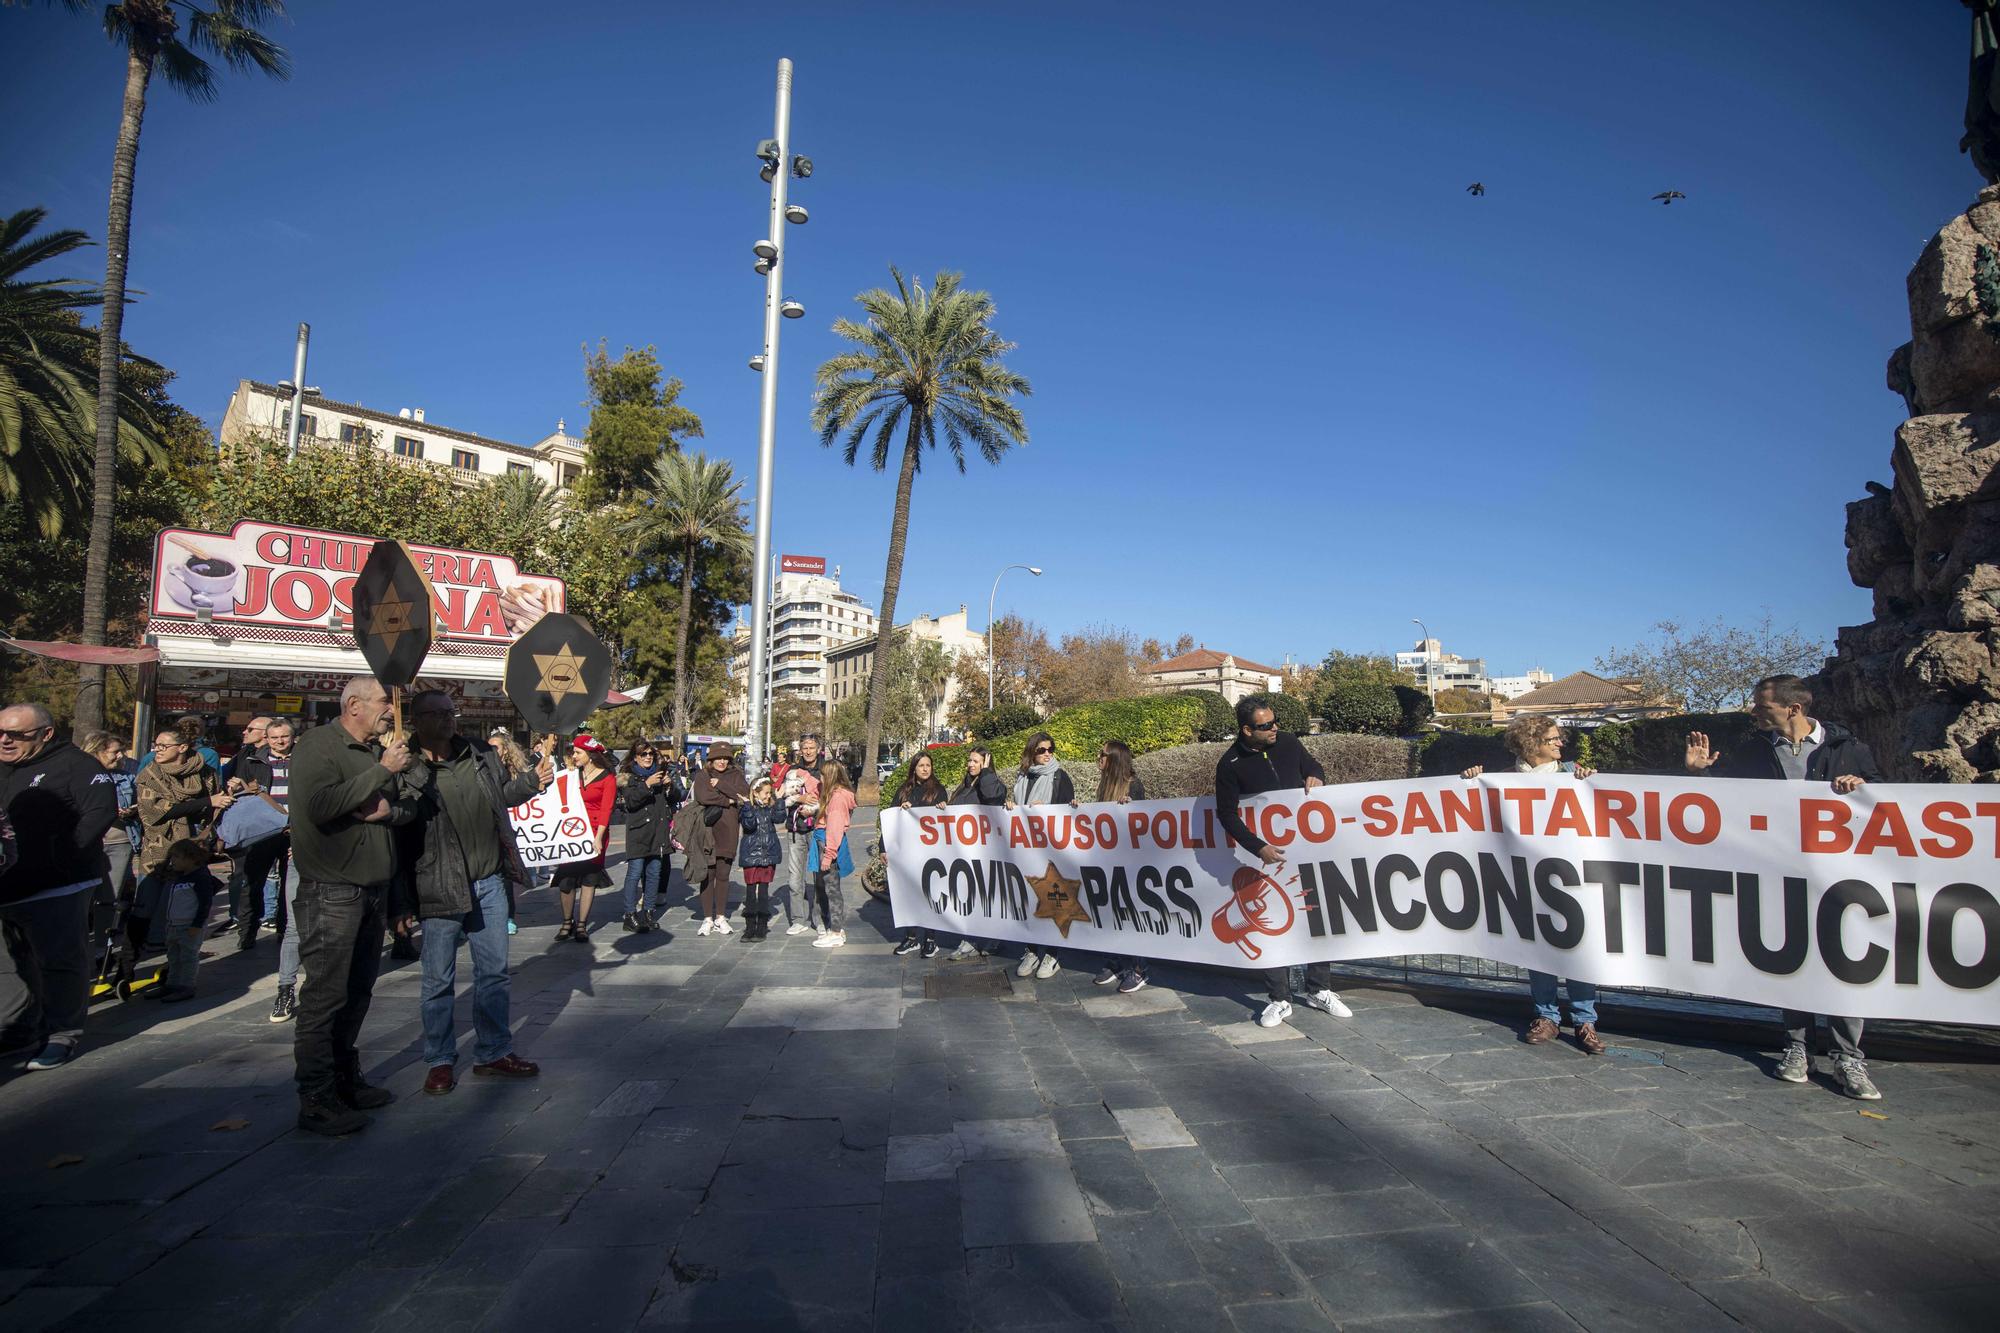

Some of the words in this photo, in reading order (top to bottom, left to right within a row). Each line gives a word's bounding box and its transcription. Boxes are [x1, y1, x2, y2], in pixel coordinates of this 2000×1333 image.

[792, 561, 823, 569] Santander
[919, 813, 992, 846] STOP
[1009, 812, 1119, 850] ABUSO
[921, 857, 1029, 921] COVID
[1080, 864, 1203, 939] PASS
[1297, 851, 2000, 990] INCONSTITUCIO
